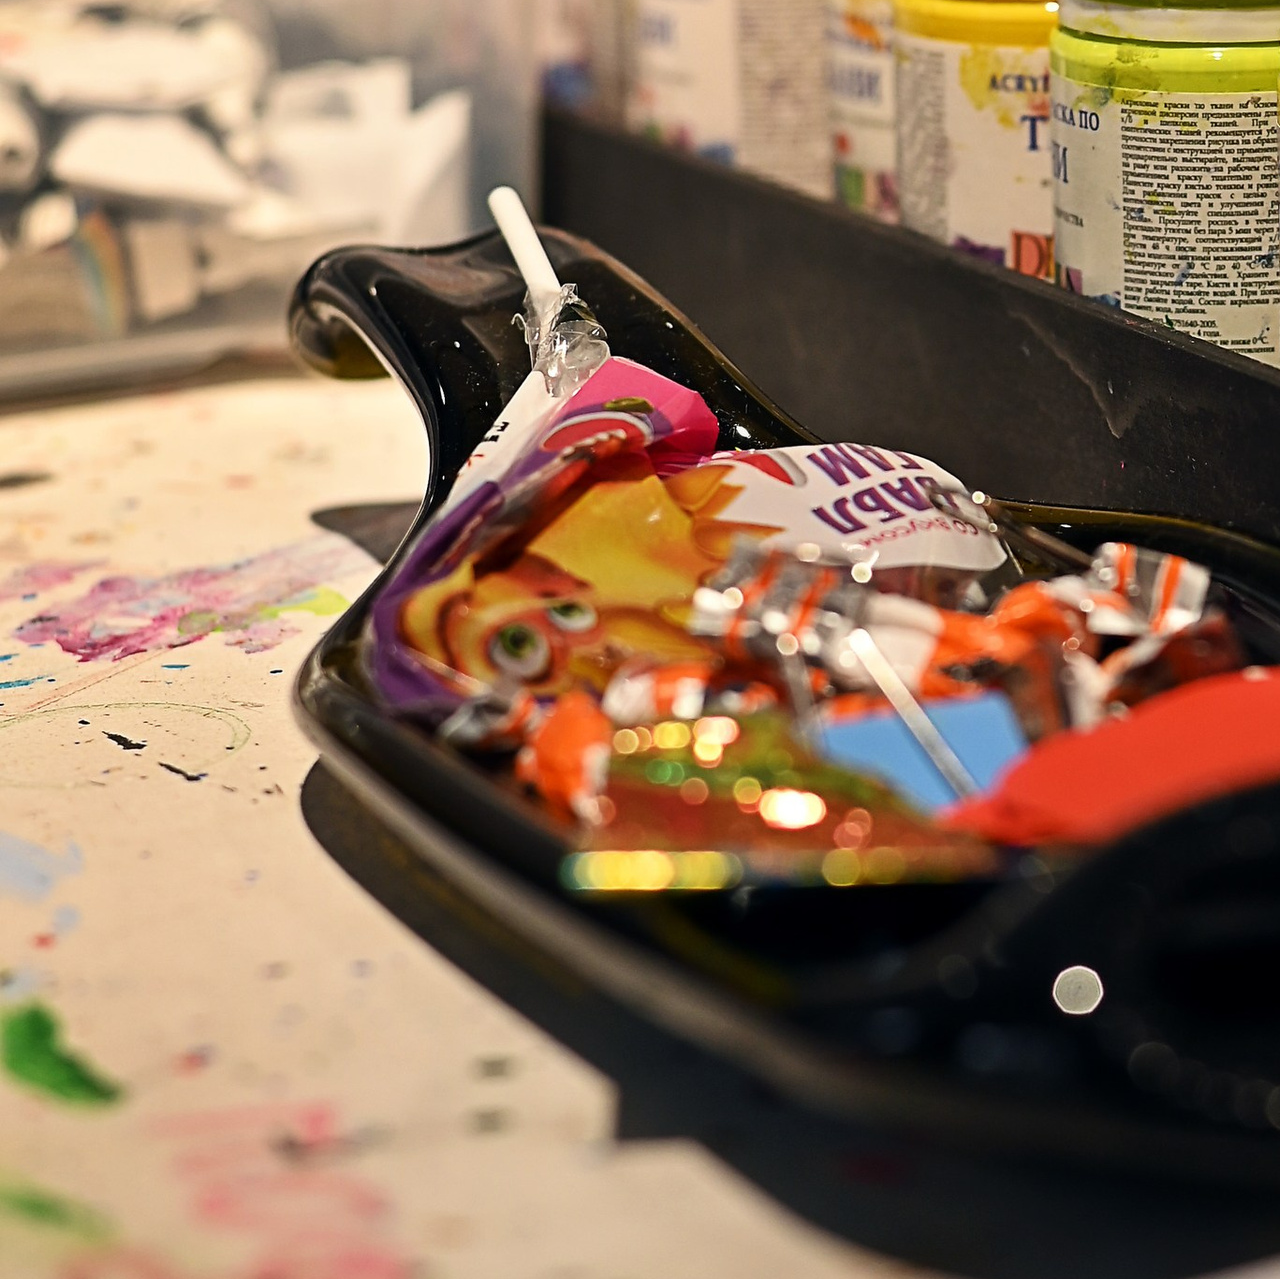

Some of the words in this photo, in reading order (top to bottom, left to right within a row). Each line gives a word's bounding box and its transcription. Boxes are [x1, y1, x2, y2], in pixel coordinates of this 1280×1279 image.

[1121, 98, 1159, 108] Акриловые
[1079, 109, 1099, 131] ПО
[1252, 119, 1268, 127] При
[1206, 130, 1262, 138] рекомендуется
[1208, 139, 1239, 147] рисунка
[1133, 163, 1149, 171] раму
[1228, 164, 1259, 174] рабочем
[1178, 174, 1203, 182] краску
[1123, 187, 1135, 195] Для
[1157, 182, 1181, 191] краску
[1159, 216, 1201, 226] Просушите
[1208, 218, 1238, 227] роспись
[1164, 227, 1191, 235] утюгом
[1208, 228, 1226, 236] пара
[1216, 263, 1225, 271] до
[1237, 271, 1269, 279] Храните
[1186, 280, 1203, 288] таре.
[1207, 279, 1230, 288] Кисти
[1145, 287, 1170, 295] работы
[1241, 289, 1258, 297] При
